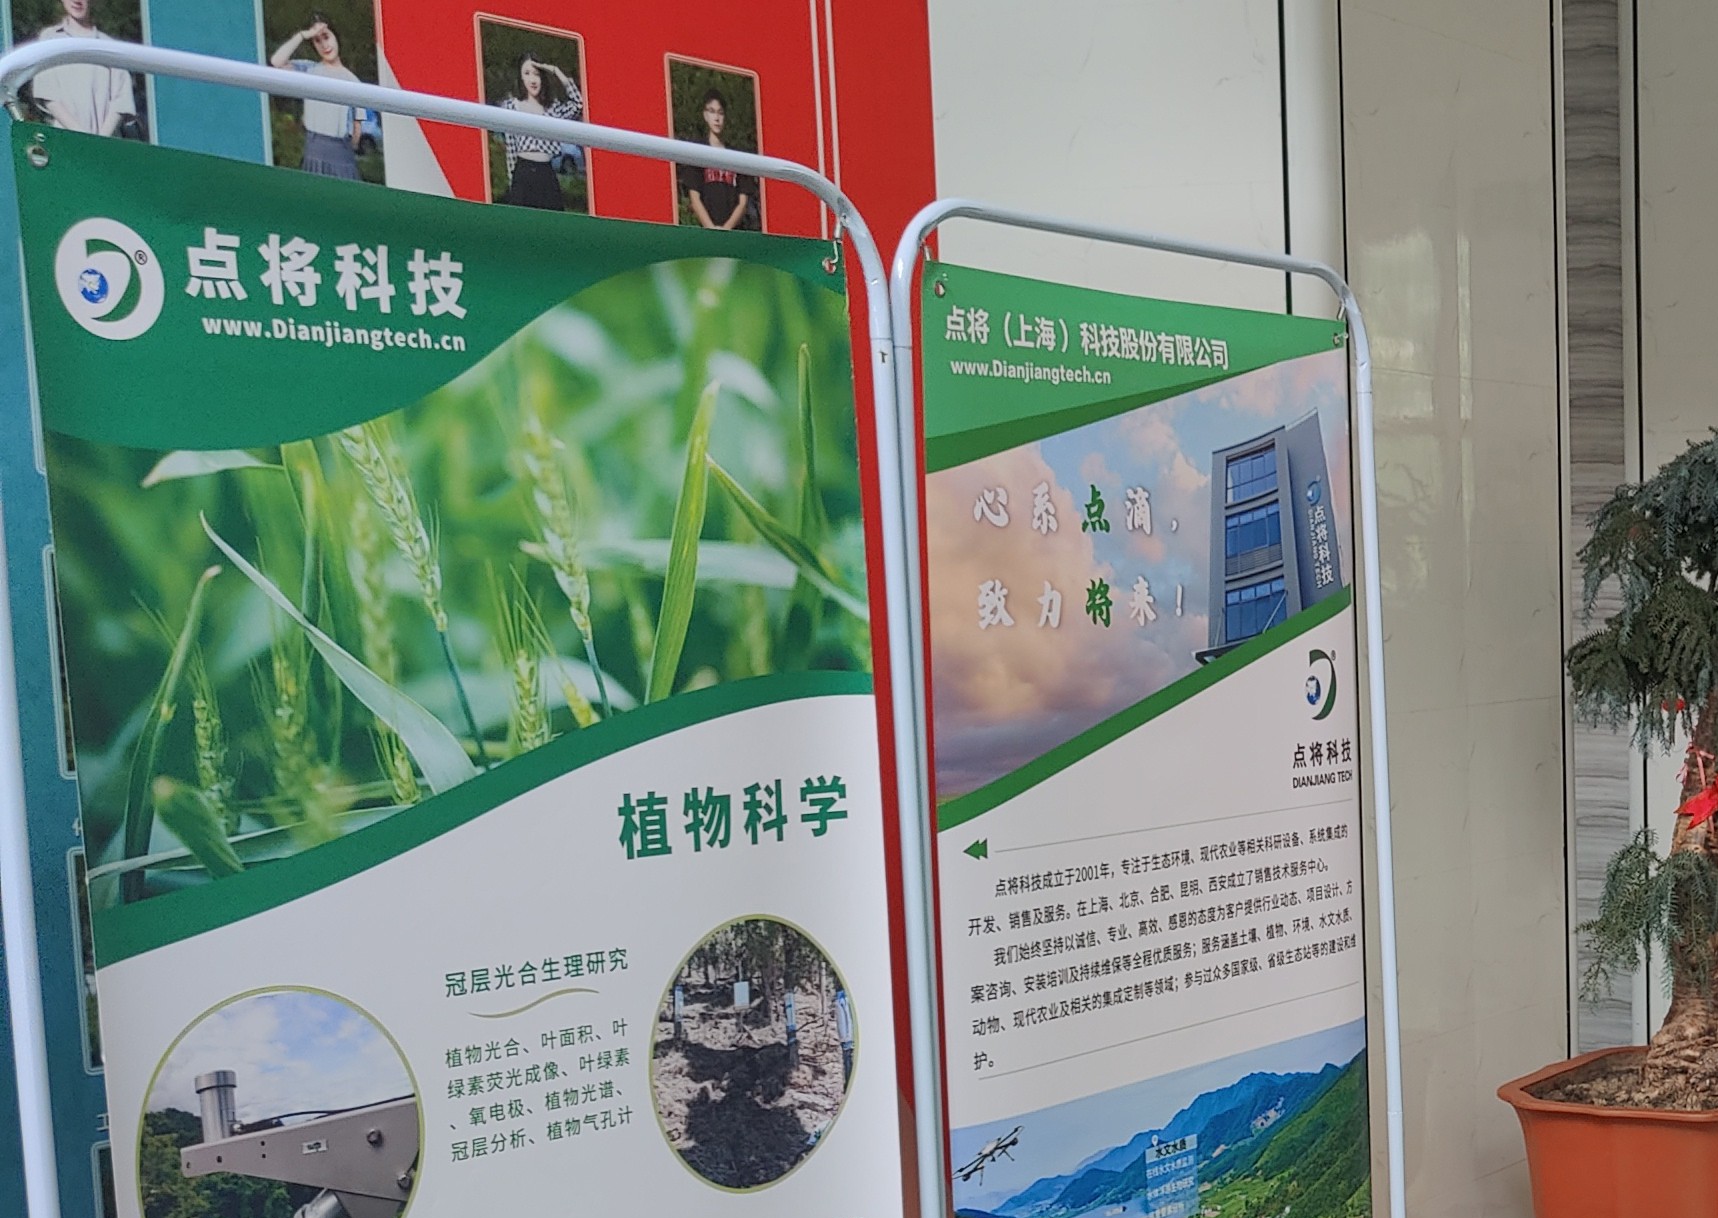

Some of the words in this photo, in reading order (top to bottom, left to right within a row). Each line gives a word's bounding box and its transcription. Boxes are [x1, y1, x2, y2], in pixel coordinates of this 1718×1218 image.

[184, 226, 468, 320] 点将科技
[202, 316, 467, 353] www.Dianjiangtech.cn
[944, 306, 1229, 371] 点将（上海）科技股份有限公司
[950, 358, 1112, 386] www.Dianjiangtech.cn
[1313, 505, 1335, 586] 点将科技
[1292, 738, 1352, 770] 点将科技
[1292, 771, 1336, 790] DIANJIANG
[1337, 769, 1353, 784] TECH
[617, 775, 849, 861] 植物科学
[445, 947, 628, 998] 冠层光合生理研究
[445, 1018, 628, 1069] 植物光合、叶面积、叶
[973, 1051, 994, 1071] 护。
[447, 1047, 630, 1099] 绿素荧光成像、叶绿素
[451, 1105, 633, 1163] 冠层分析、植物气孔计
